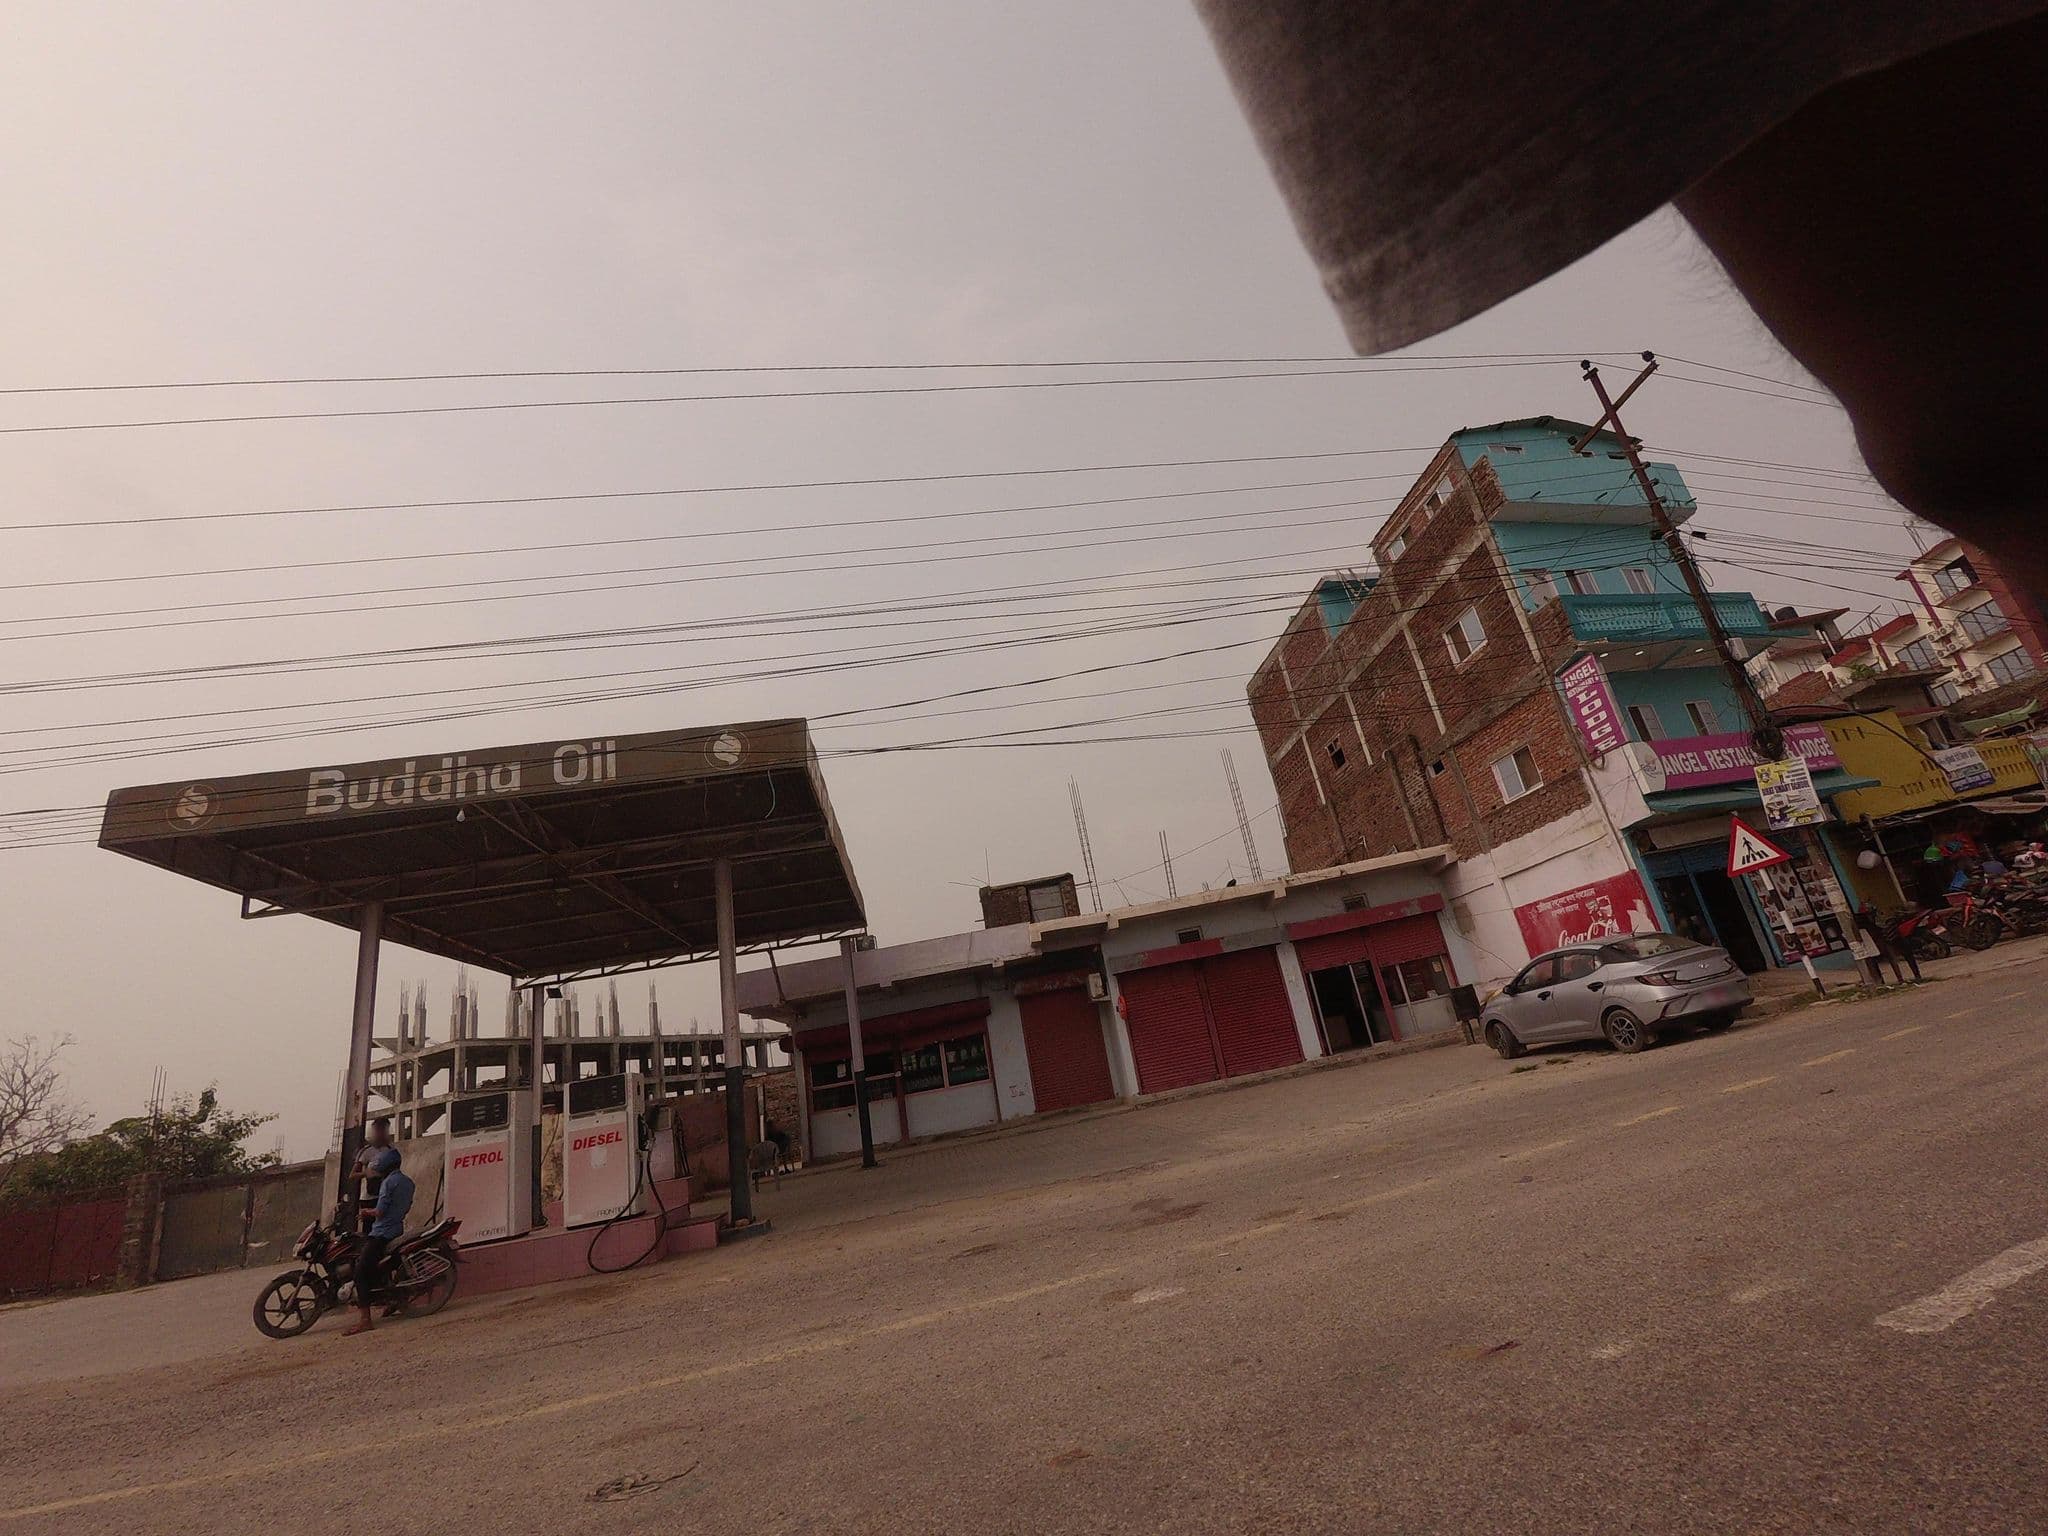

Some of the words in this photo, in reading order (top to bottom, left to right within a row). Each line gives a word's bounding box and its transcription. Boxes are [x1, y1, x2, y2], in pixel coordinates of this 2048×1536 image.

[1565, 663, 1596, 690] ANGEL
[1576, 689, 1618, 752] LODGE
[1661, 750, 1709, 776] ANGEL
[1705, 743, 1768, 771] RESTAU
[1792, 736, 1835, 759] LODGE
[305, 756, 522, 816] Buddha
[552, 740, 617, 787] Oil
[1558, 918, 1620, 948] Coca-Cla
[573, 1131, 623, 1151] DIESEL
[454, 1150, 504, 1169] PETROL
[597, 1205, 627, 1217] FRONTIE
